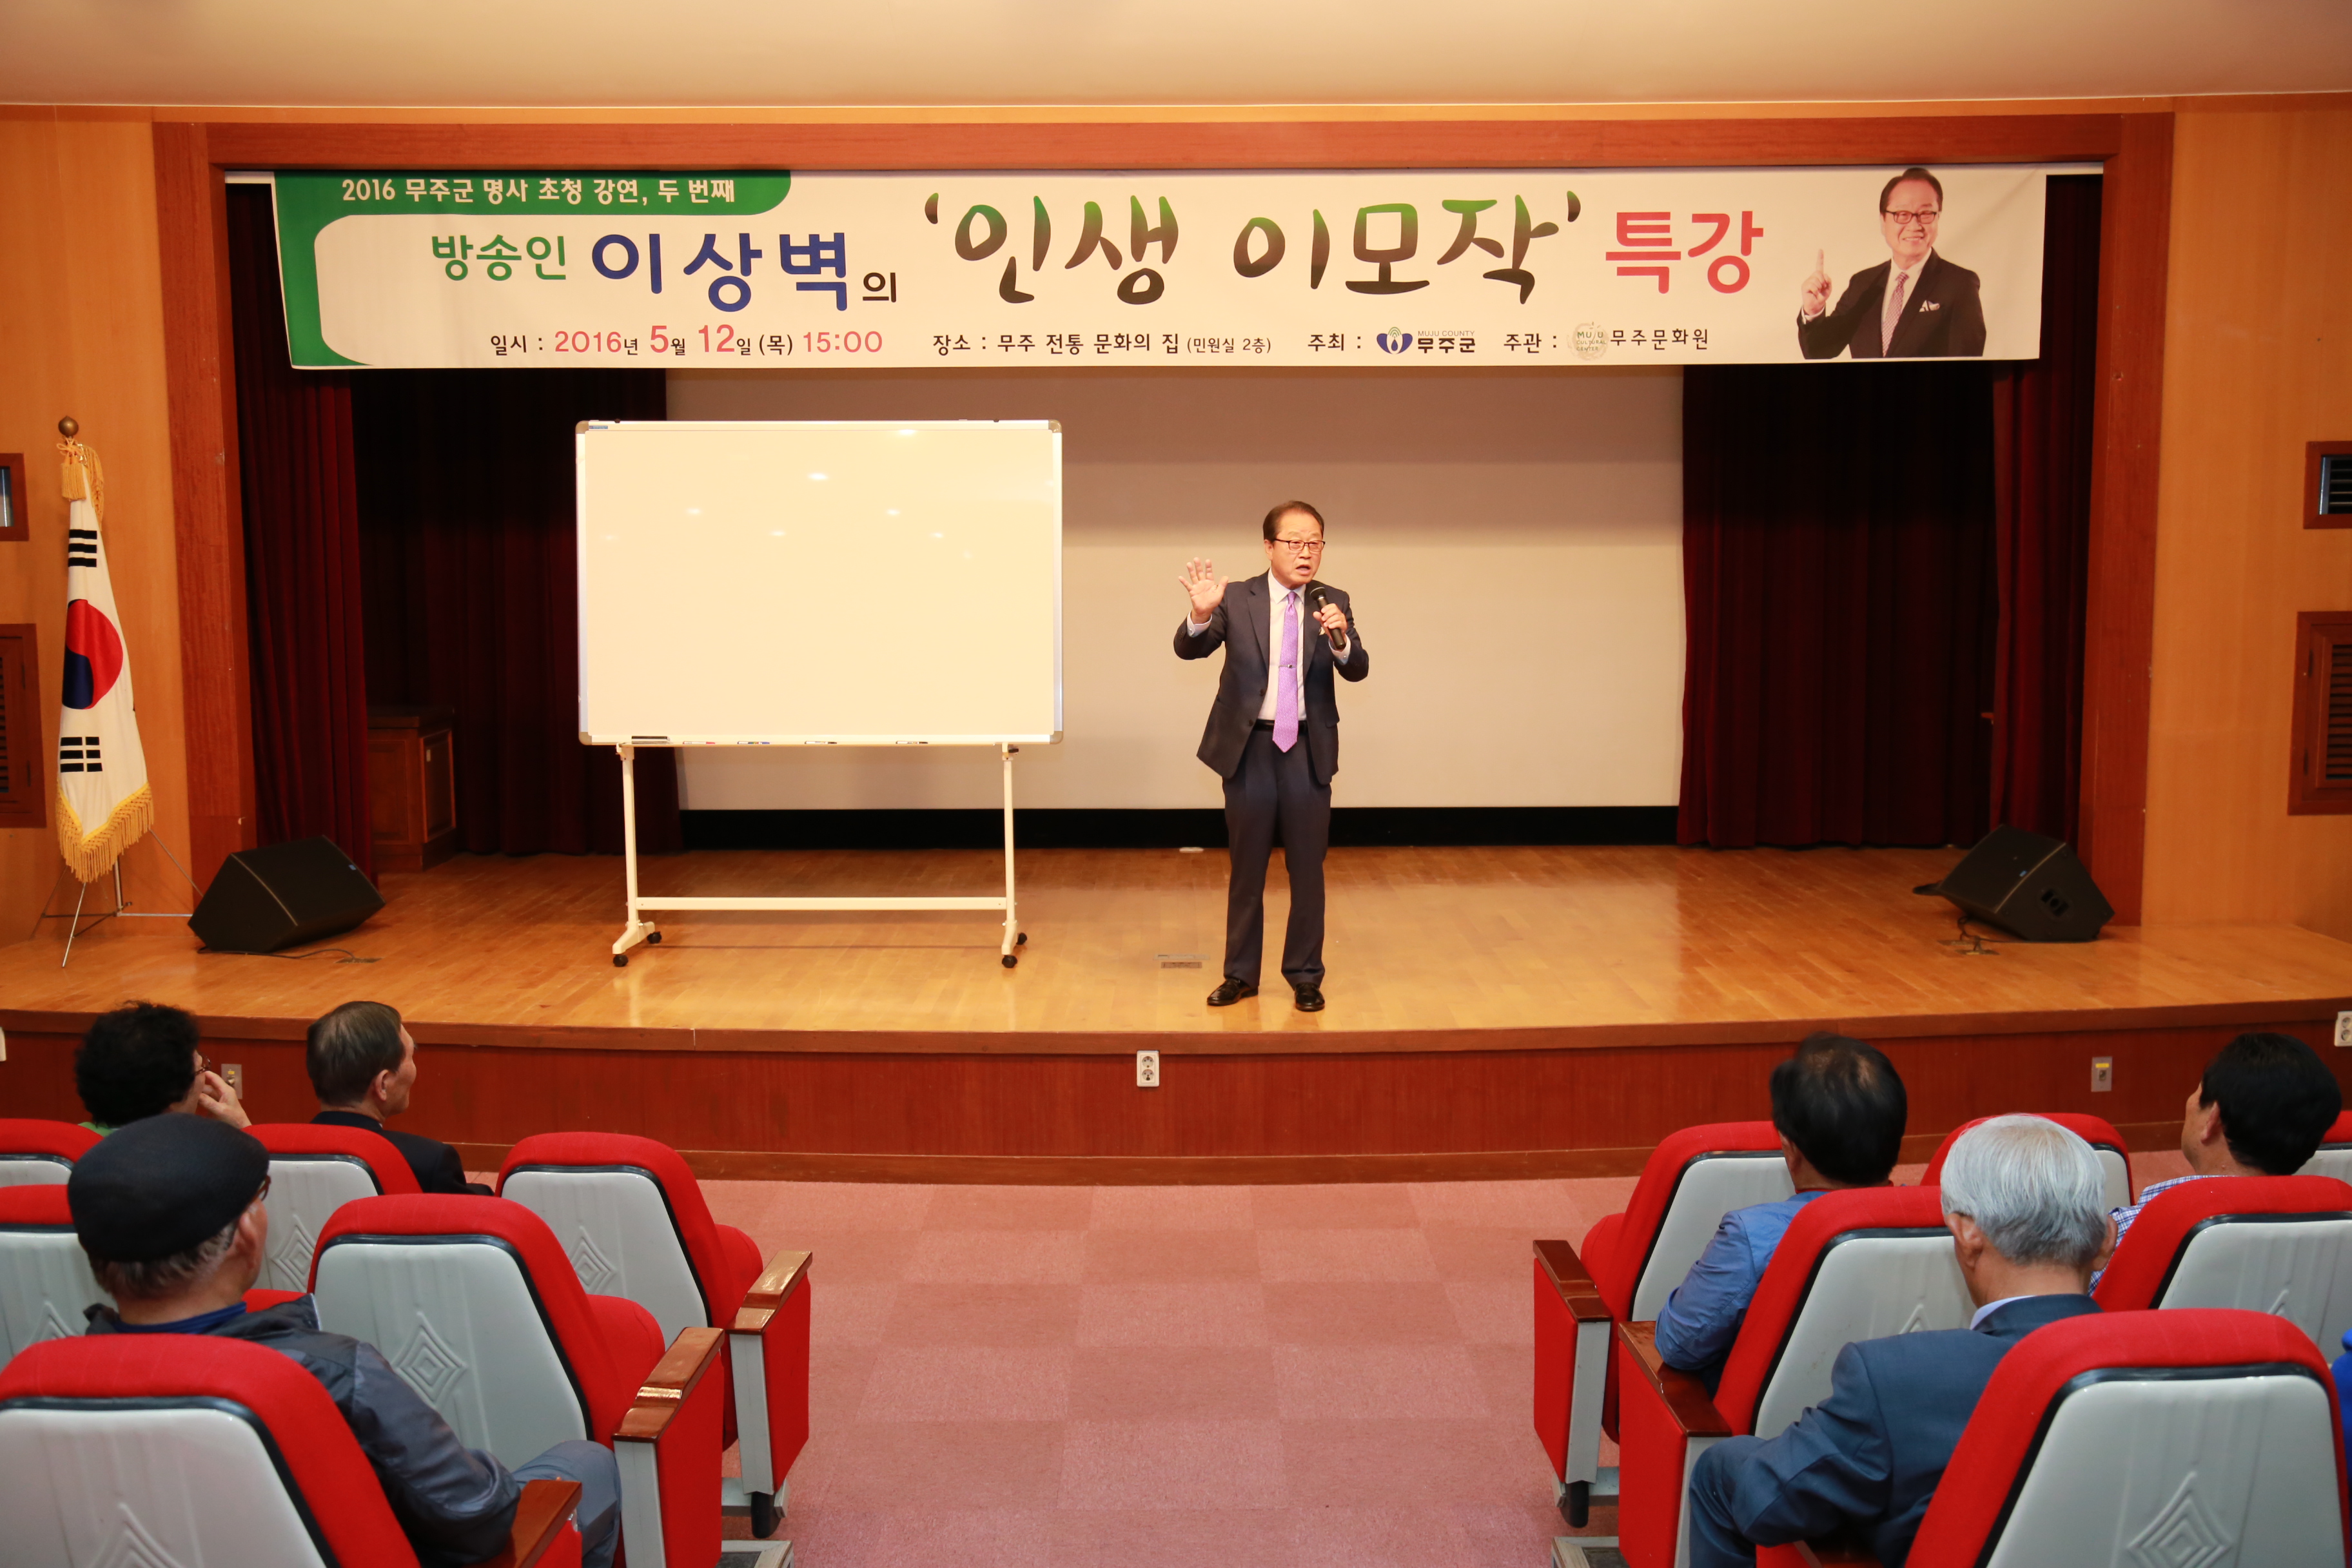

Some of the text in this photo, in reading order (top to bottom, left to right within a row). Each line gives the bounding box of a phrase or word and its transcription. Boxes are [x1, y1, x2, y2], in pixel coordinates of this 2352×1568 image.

[342, 177, 735, 206] 2016 무주군 명사 초청 강연, 두 번째
[431, 235, 567, 282] 방송인
[1605, 210, 1764, 295] 특강
[491, 335, 527, 356] 일시
[554, 330, 638, 356] 2016년
[650, 325, 686, 356] 5월
[698, 324, 752, 356] 12일
[758, 334, 793, 356] (목)
[803, 330, 883, 353] 15:00
[933, 334, 971, 356] 장소
[997, 335, 1035, 353] 무주
[1046, 333, 1084, 355] 전통
[1093, 333, 1150, 354] 문화의
[1162, 333, 1179, 354] 집
[1187, 337, 1235, 354] (민원실
[1242, 337, 1271, 354] 2층)
[1308, 333, 1345, 352] 주최
[1417, 338, 1476, 353] 무주군
[1504, 333, 1542, 354] 주관
[1610, 328, 1709, 351] 무주문화원
